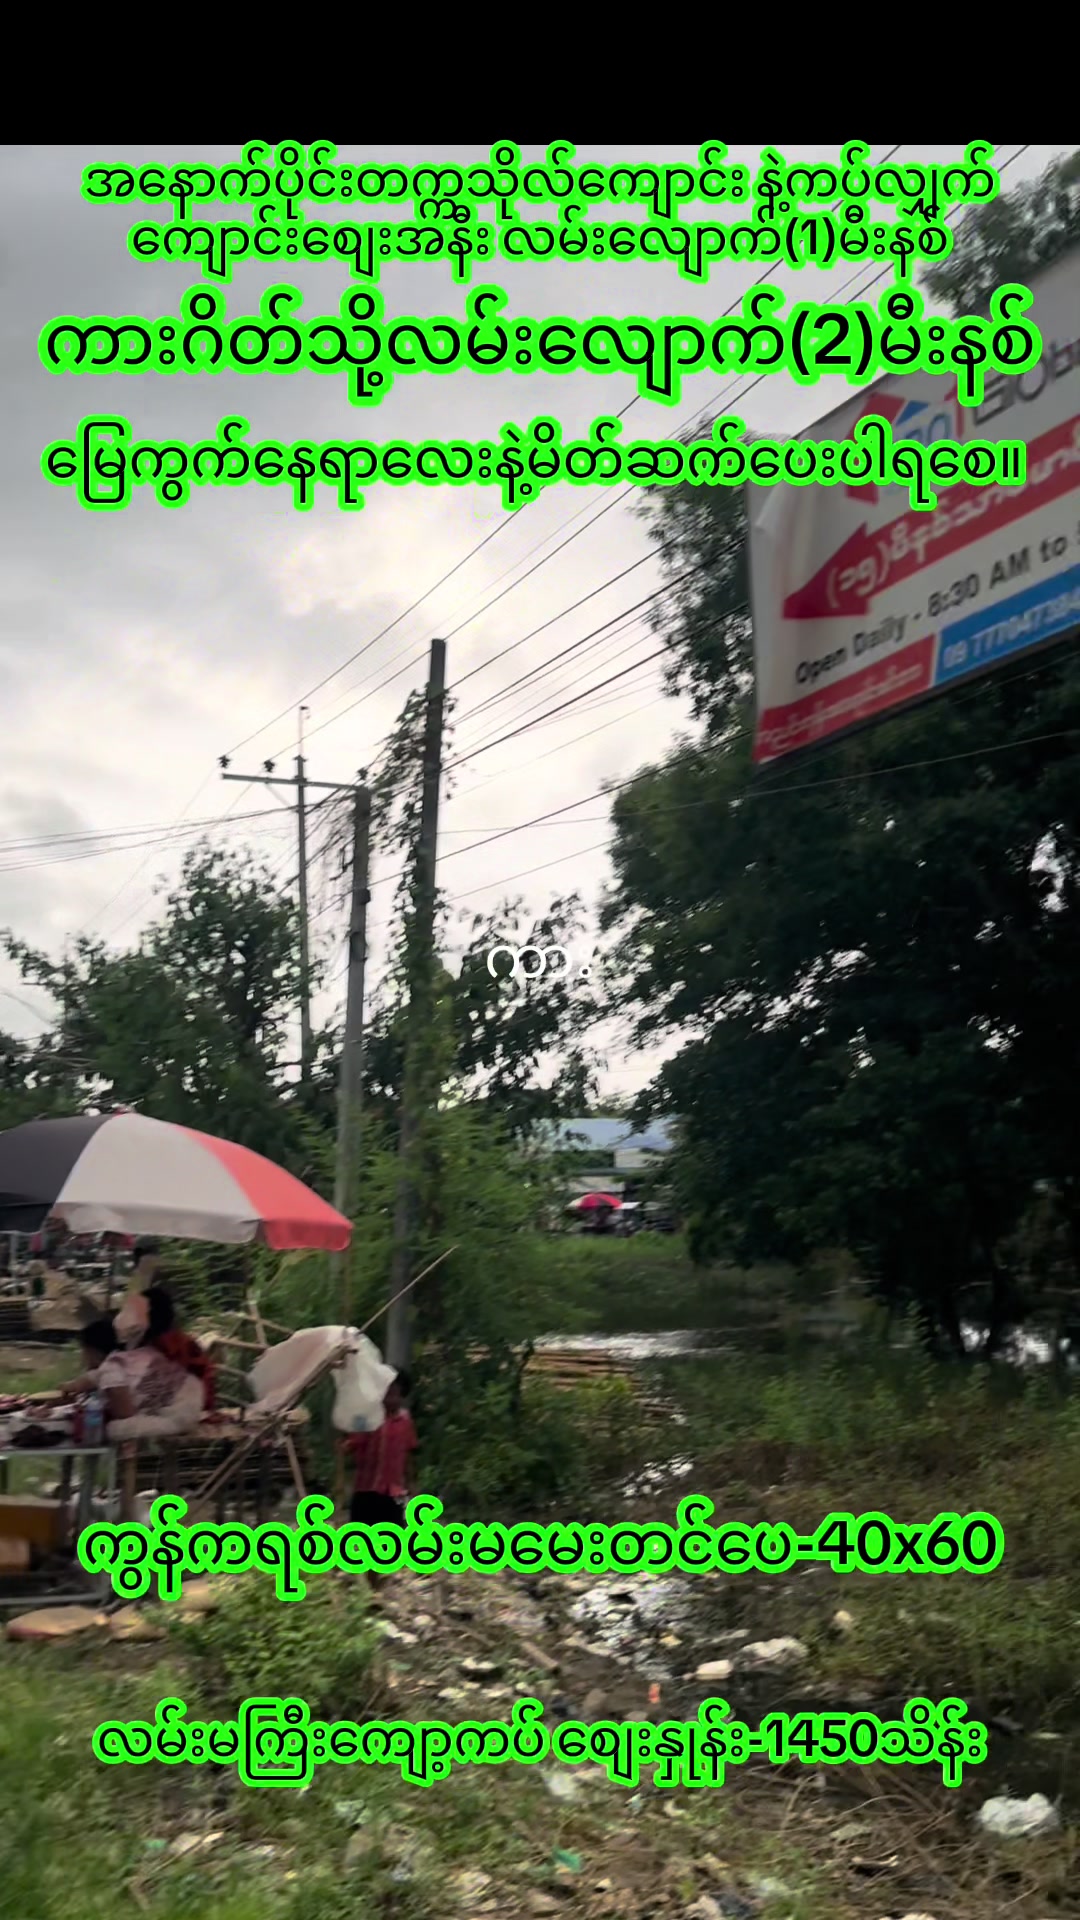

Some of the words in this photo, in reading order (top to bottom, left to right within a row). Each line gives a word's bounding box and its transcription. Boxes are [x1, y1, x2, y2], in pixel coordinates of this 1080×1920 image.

[795, 647, 848, 684] Open
[853, 614, 907, 656] Daily
[928, 573, 980, 617] 8:30
[988, 546, 1030, 589] AM
[1040, 536, 1067, 563] to
